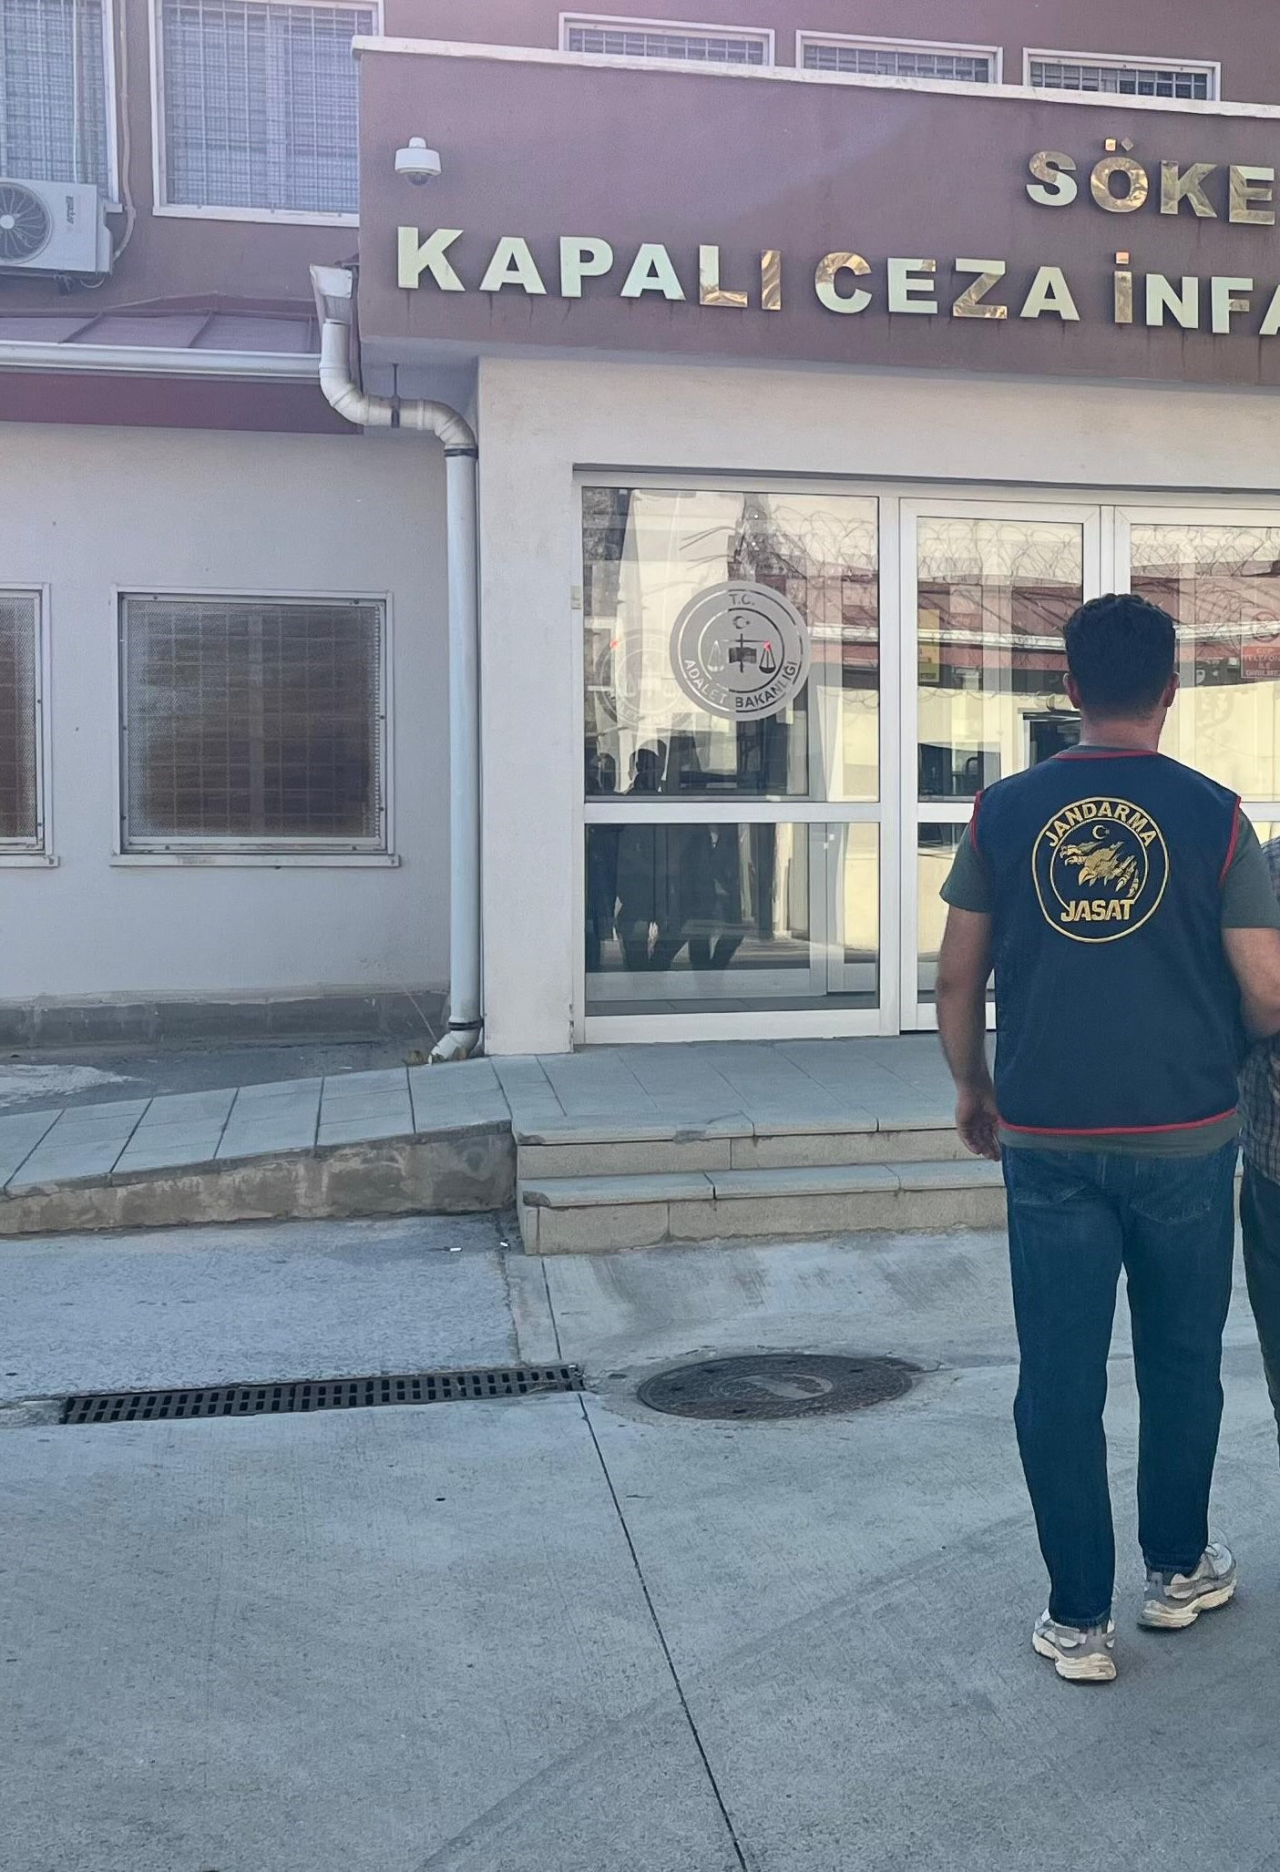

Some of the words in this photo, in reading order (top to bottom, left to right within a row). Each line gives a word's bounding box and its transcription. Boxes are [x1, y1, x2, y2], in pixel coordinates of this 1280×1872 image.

[1026, 137, 1276, 225] SÖKE
[397, 226, 782, 311] KAPALI
[814, 252, 1081, 321] CEZA
[684, 659, 728, 704] ADALET
[735, 661, 798, 708] BAKANLIĞI
[1045, 801, 1157, 848] JANDARMA
[1060, 899, 1135, 922] JASAT
